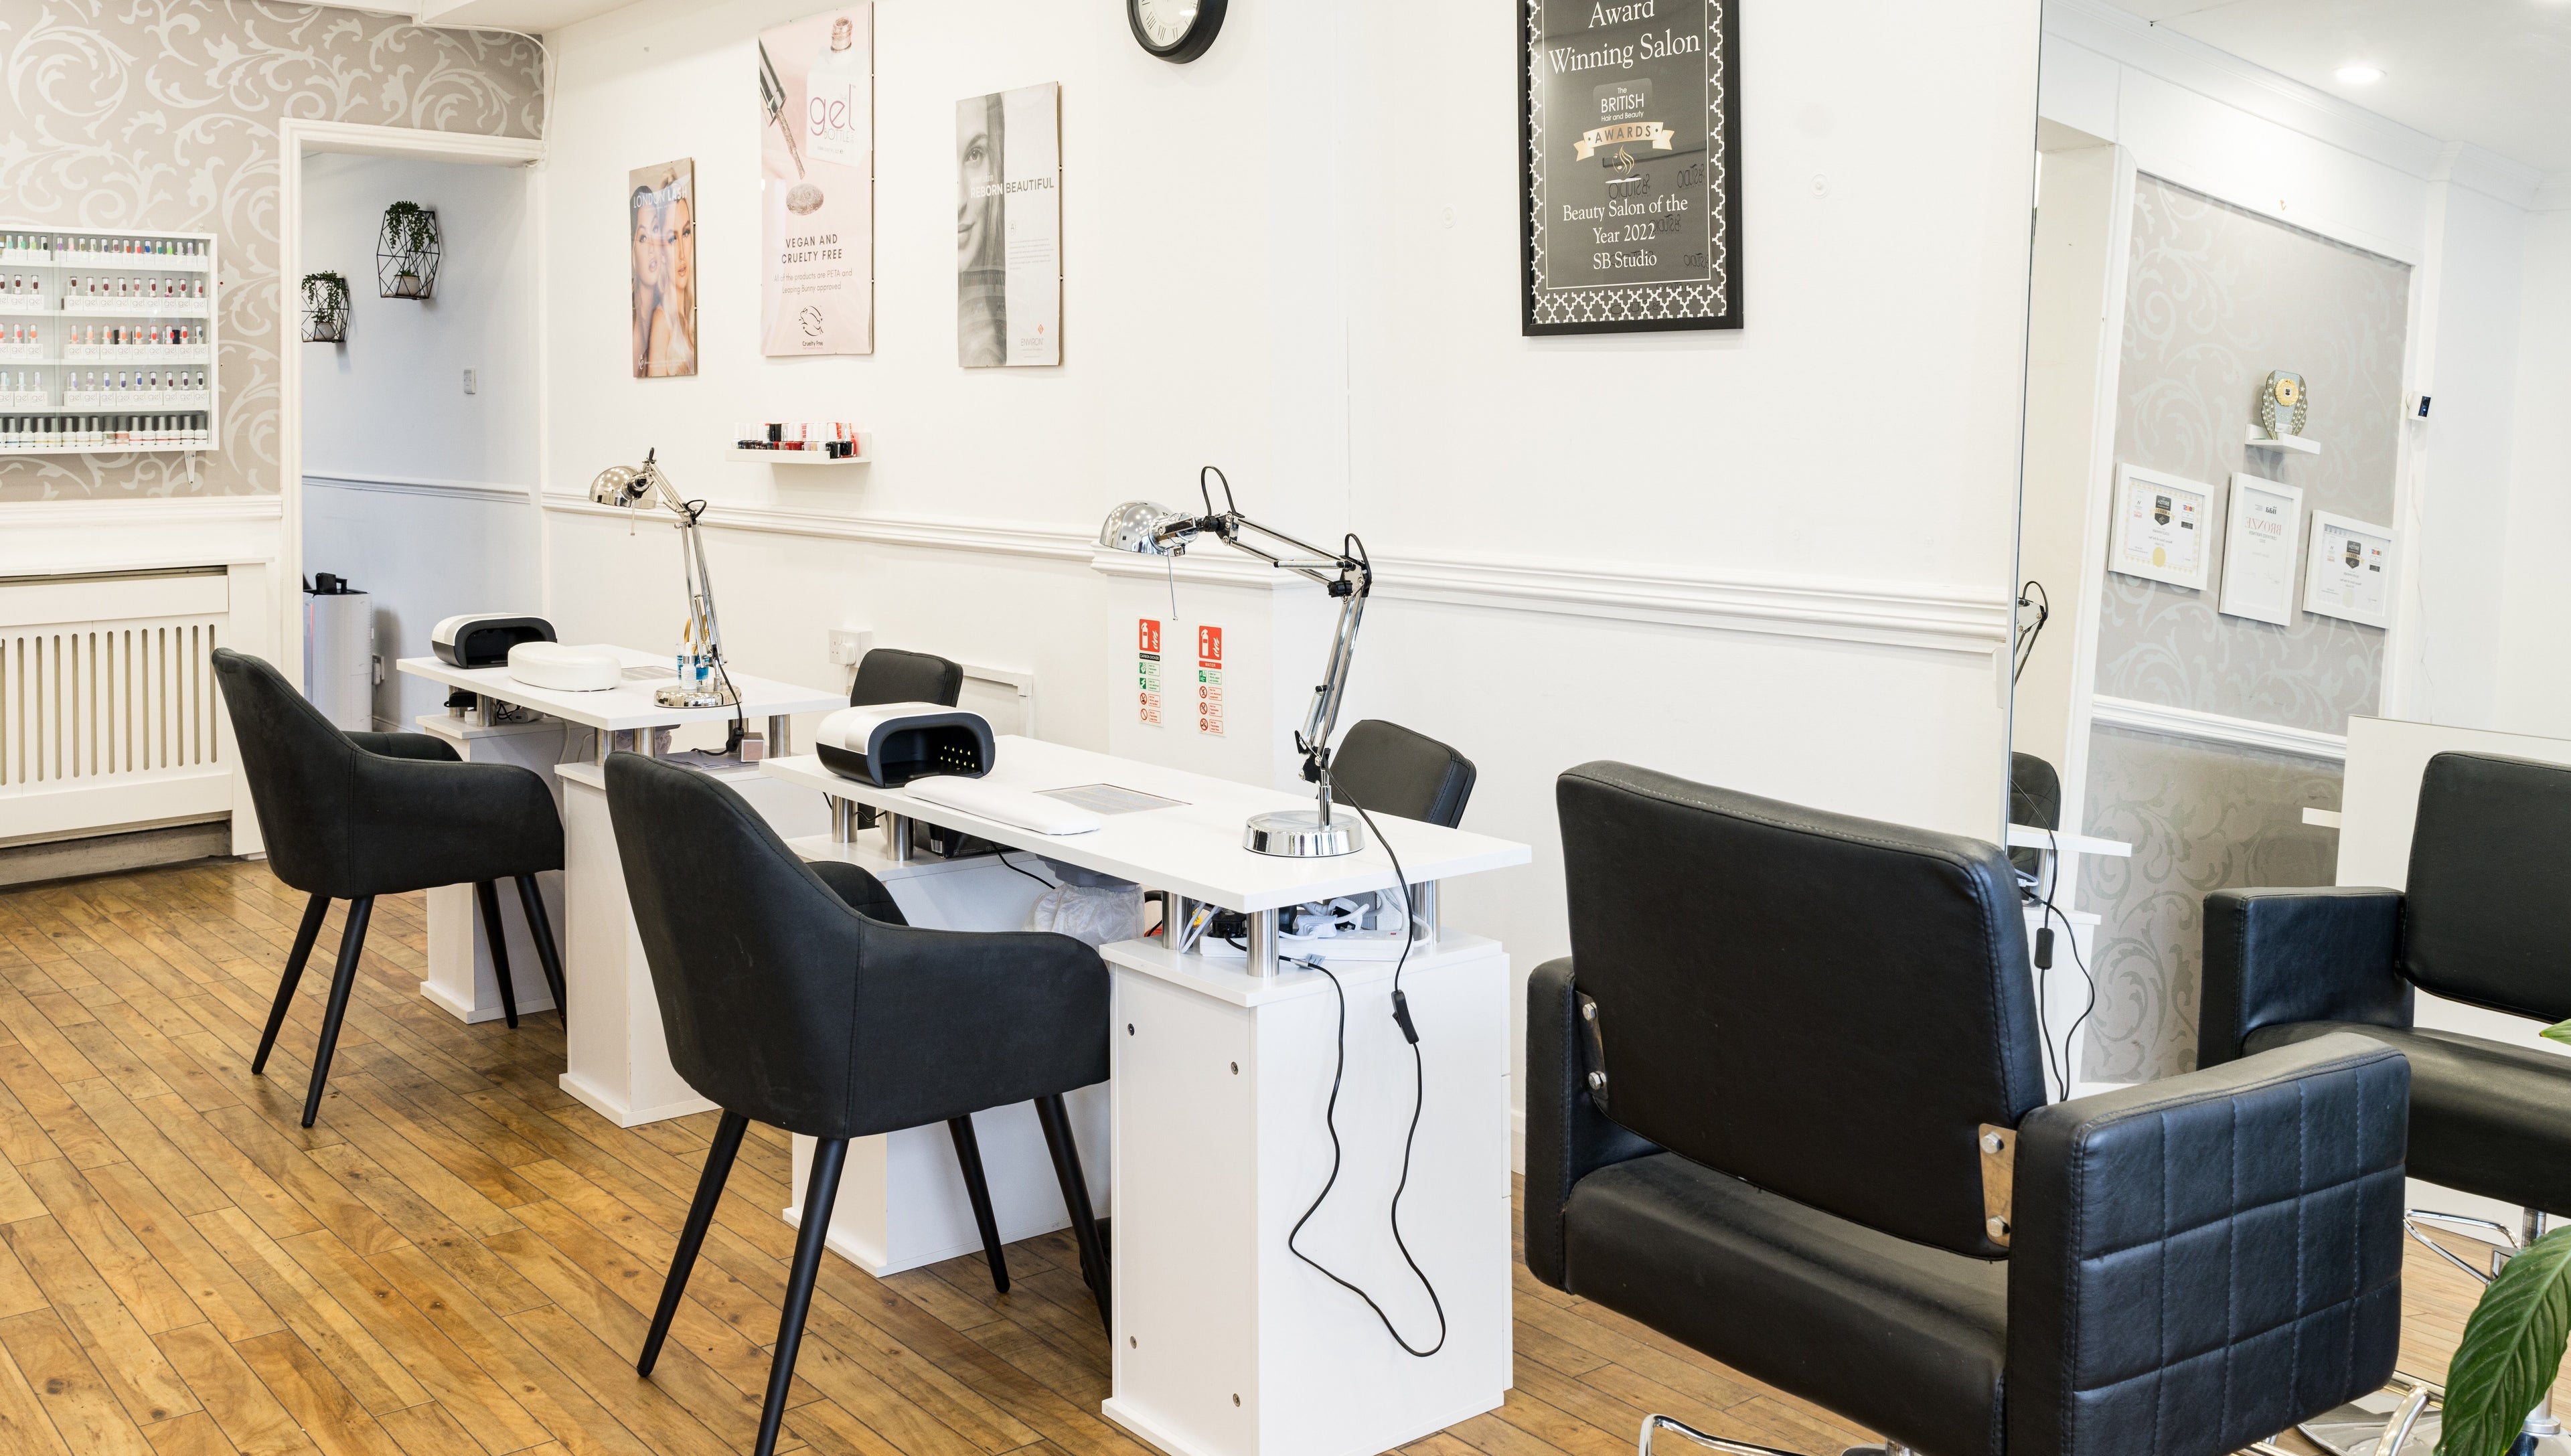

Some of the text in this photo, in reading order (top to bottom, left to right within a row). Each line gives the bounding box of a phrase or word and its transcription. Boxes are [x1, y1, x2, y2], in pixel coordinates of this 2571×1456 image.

[1589, 0, 1655, 28] Award
[1548, 28, 1701, 74] Winning Salon
[809, 84, 855, 136] gel
[1601, 92, 1644, 113] BRITISH
[1612, 112, 1624, 120] and
[1624, 110, 1644, 119] Beauty
[824, 128, 850, 143] BOTTLE
[1595, 125, 1651, 143] AWARDS
[633, 191, 665, 208] LONDON
[668, 186, 687, 201] LASH
[971, 177, 1055, 199] REBORN BEAUTIFUL
[1563, 193, 1688, 222] Beauty Salon of the
[785, 234, 838, 248] VEGAN AND
[1593, 222, 1656, 244] Year 2022
[781, 248, 842, 264] CRUELTY FREE
[1593, 252, 1612, 270] SB
[1614, 249, 1657, 268] Studio
[794, 272, 815, 282] products
[827, 269, 840, 278] PETA
[842, 268, 852, 277] and
[782, 281, 842, 295] Leaping Bunny approved
[1021, 337, 1043, 346] ENVIRON
